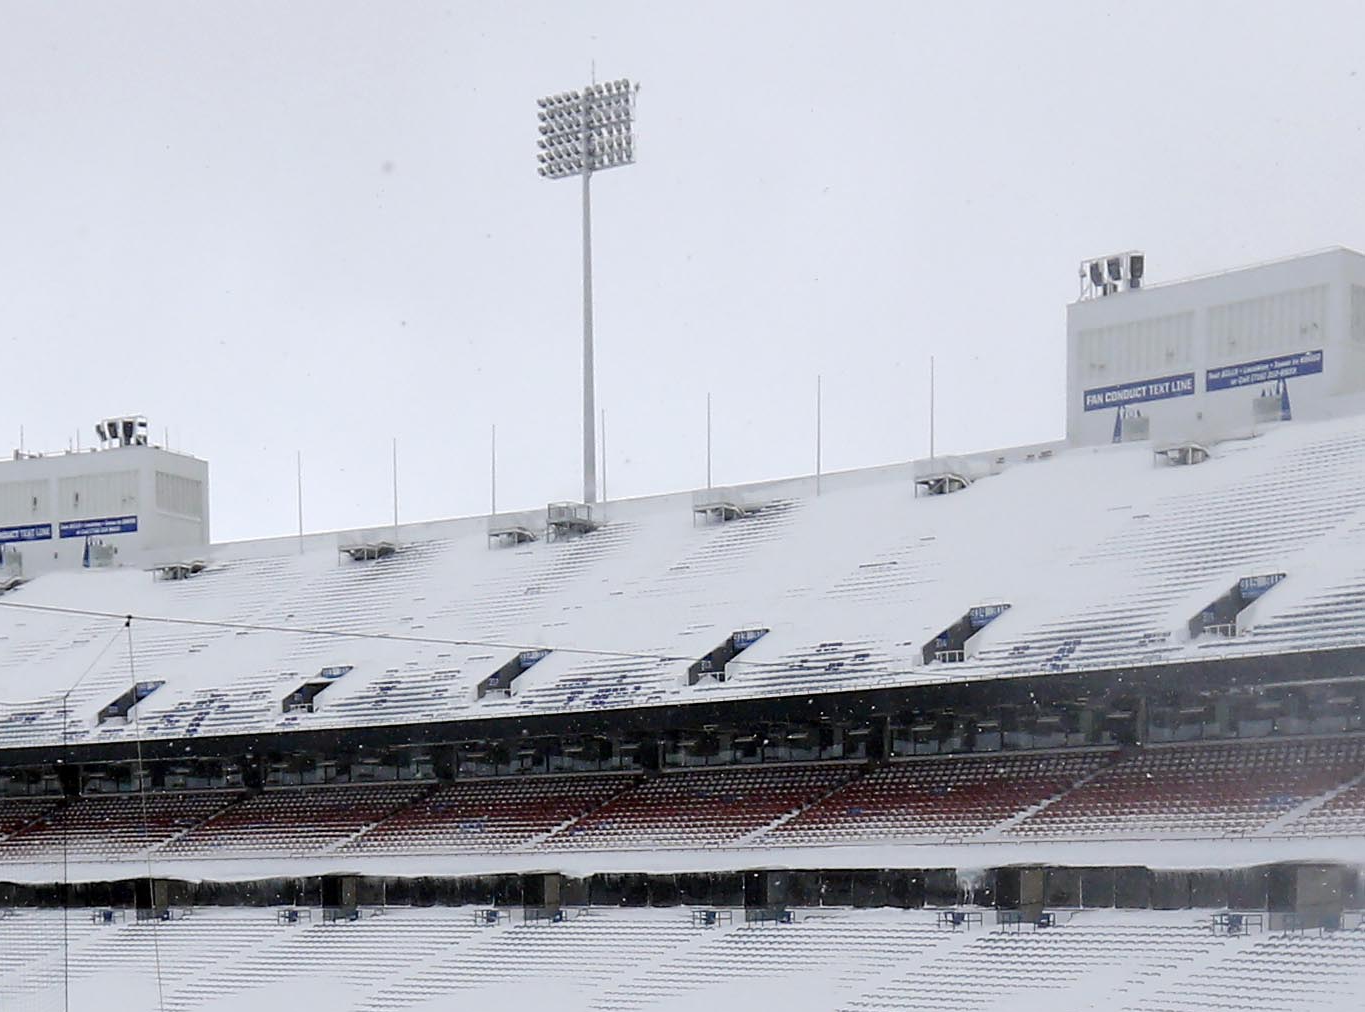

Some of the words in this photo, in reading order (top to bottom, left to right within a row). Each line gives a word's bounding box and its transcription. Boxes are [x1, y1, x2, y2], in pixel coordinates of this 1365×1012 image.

[1086, 394, 1103, 405] FAN
[1105, 386, 1147, 402] CONDUCT
[1149, 382, 1170, 396] TEXT
[1171, 378, 1193, 392] LINE
